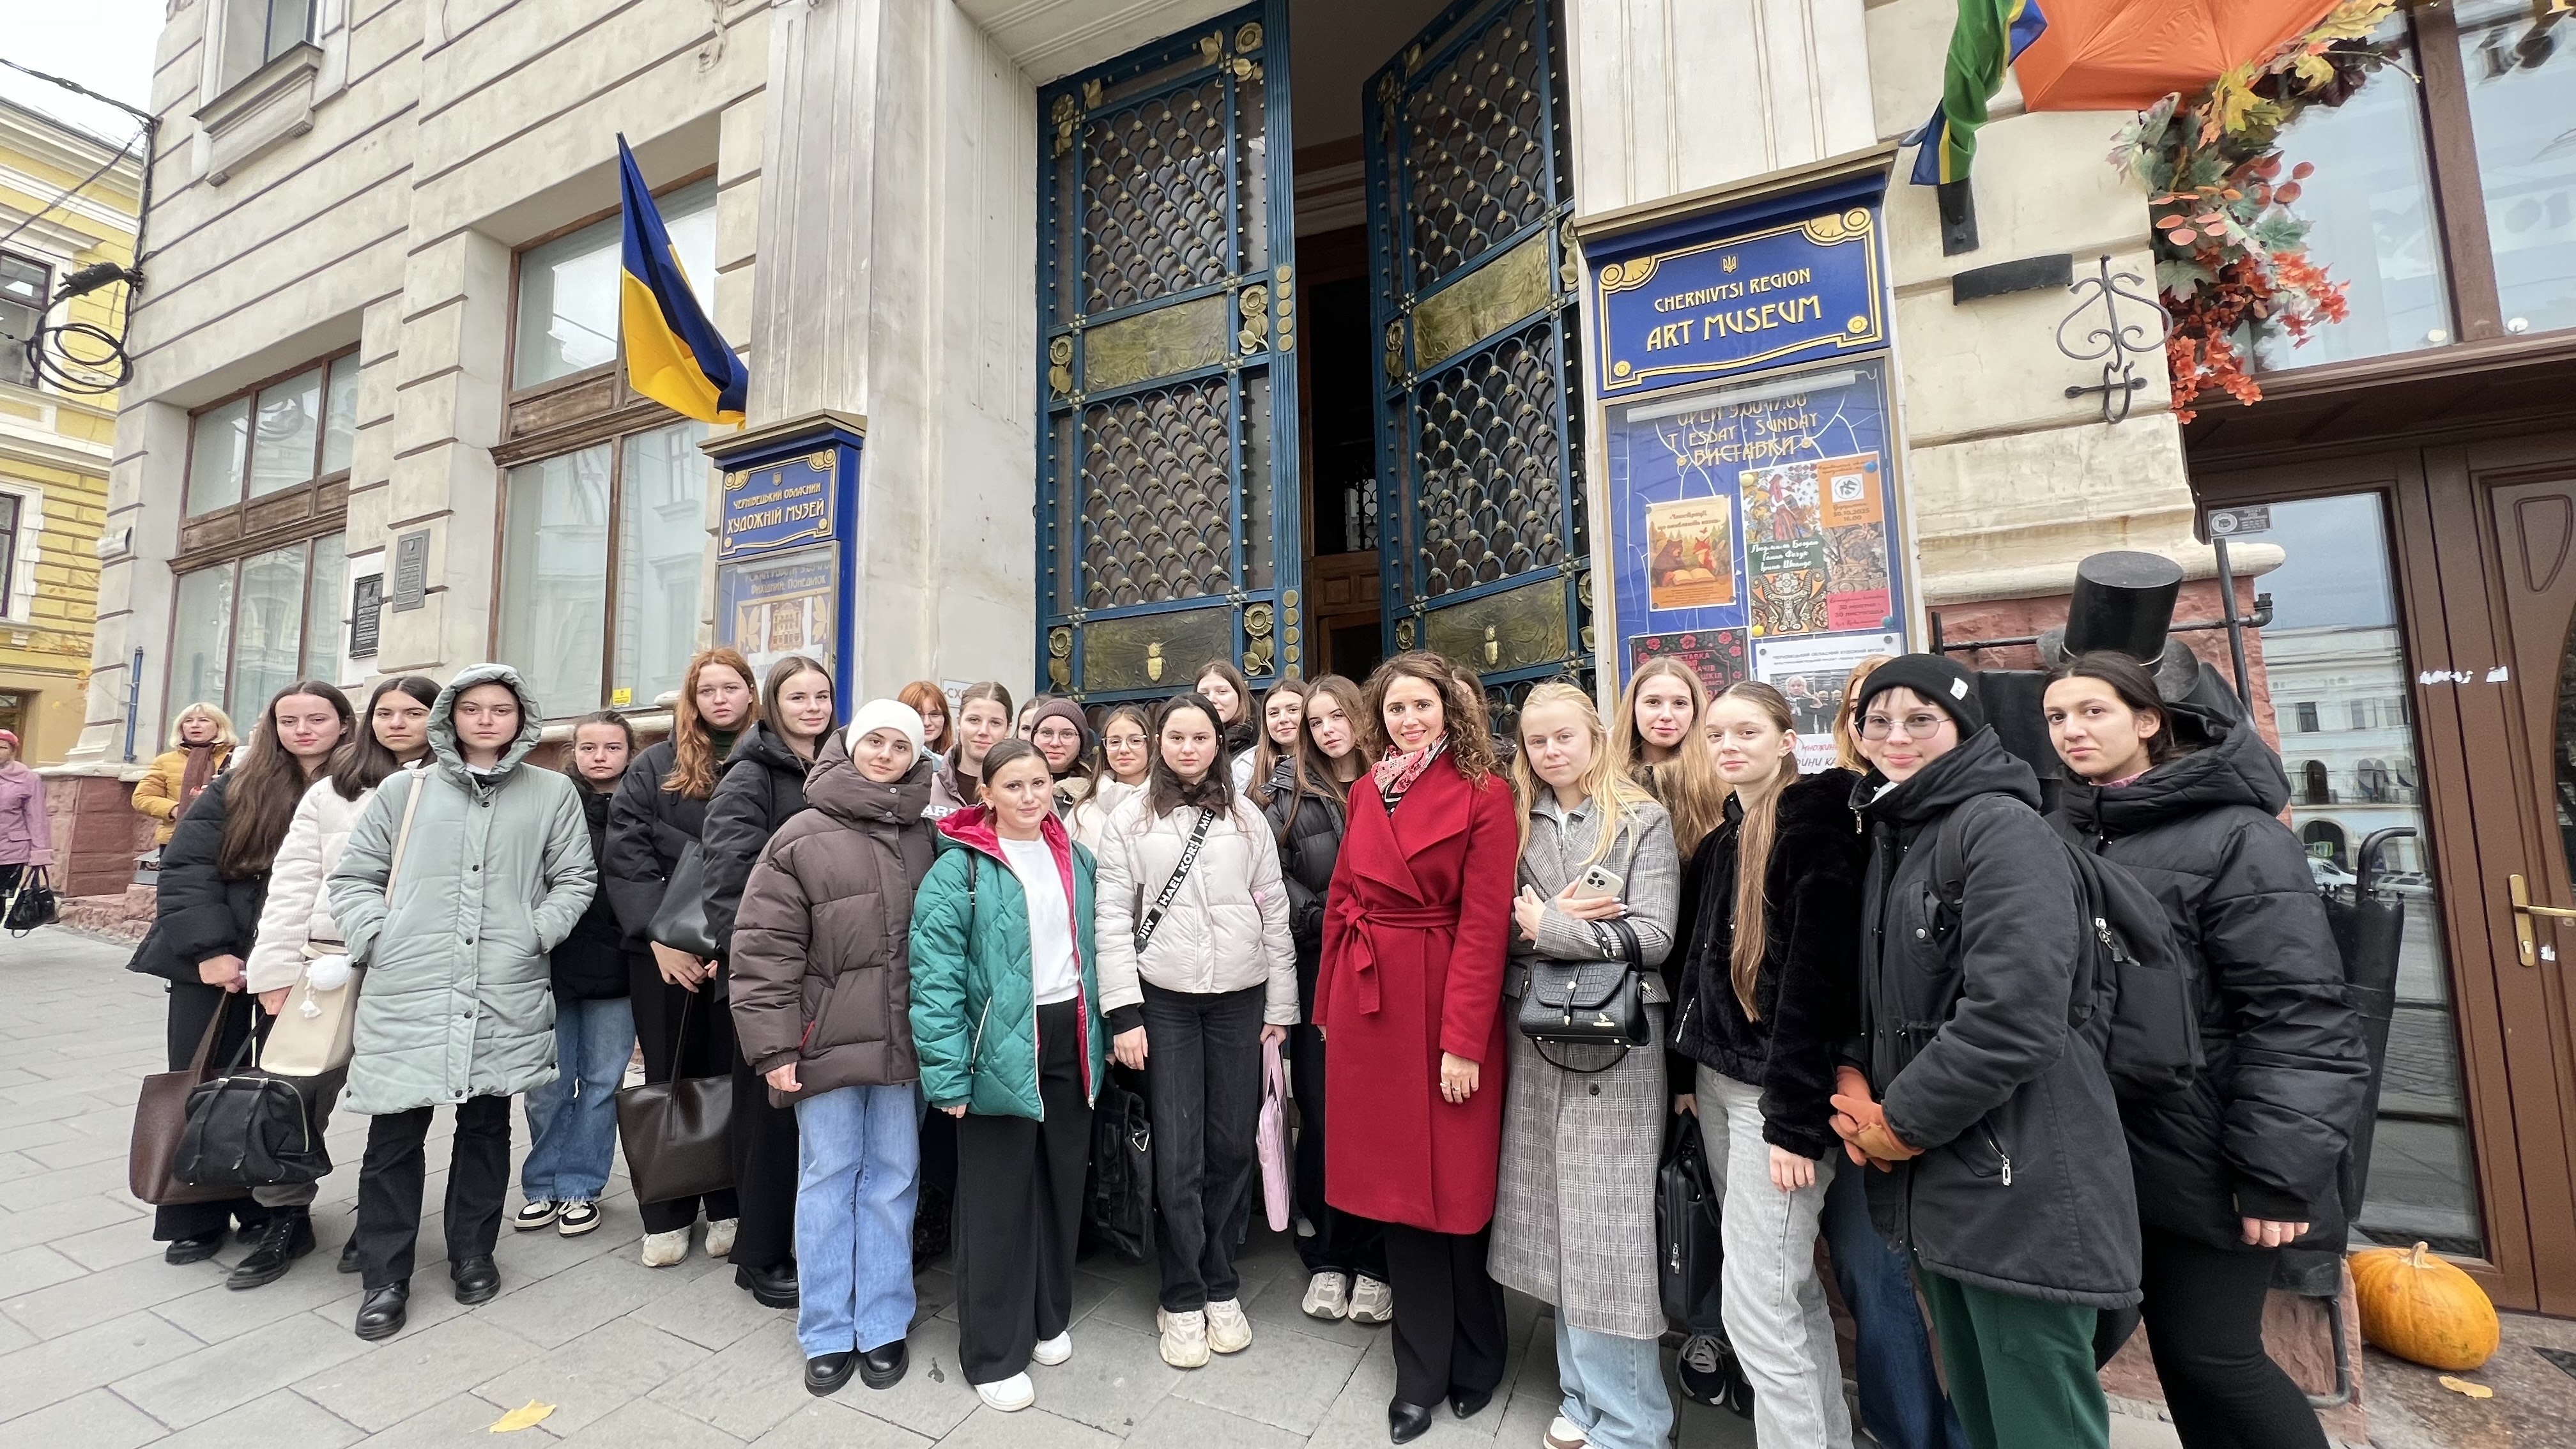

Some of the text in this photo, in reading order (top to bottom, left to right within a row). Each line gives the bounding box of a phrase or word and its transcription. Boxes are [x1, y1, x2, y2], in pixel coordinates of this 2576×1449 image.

[1655, 268, 1811, 312] CHERNIVTSI REGION
[1647, 295, 1821, 351] ART MUSEUM
[1755, 413, 1818, 436] SUNDAY
[1694, 437, 1795, 466] ВИСТАВКИ
[727, 498, 825, 535] ХУДОЖНІЙ МУЗЕЙ
